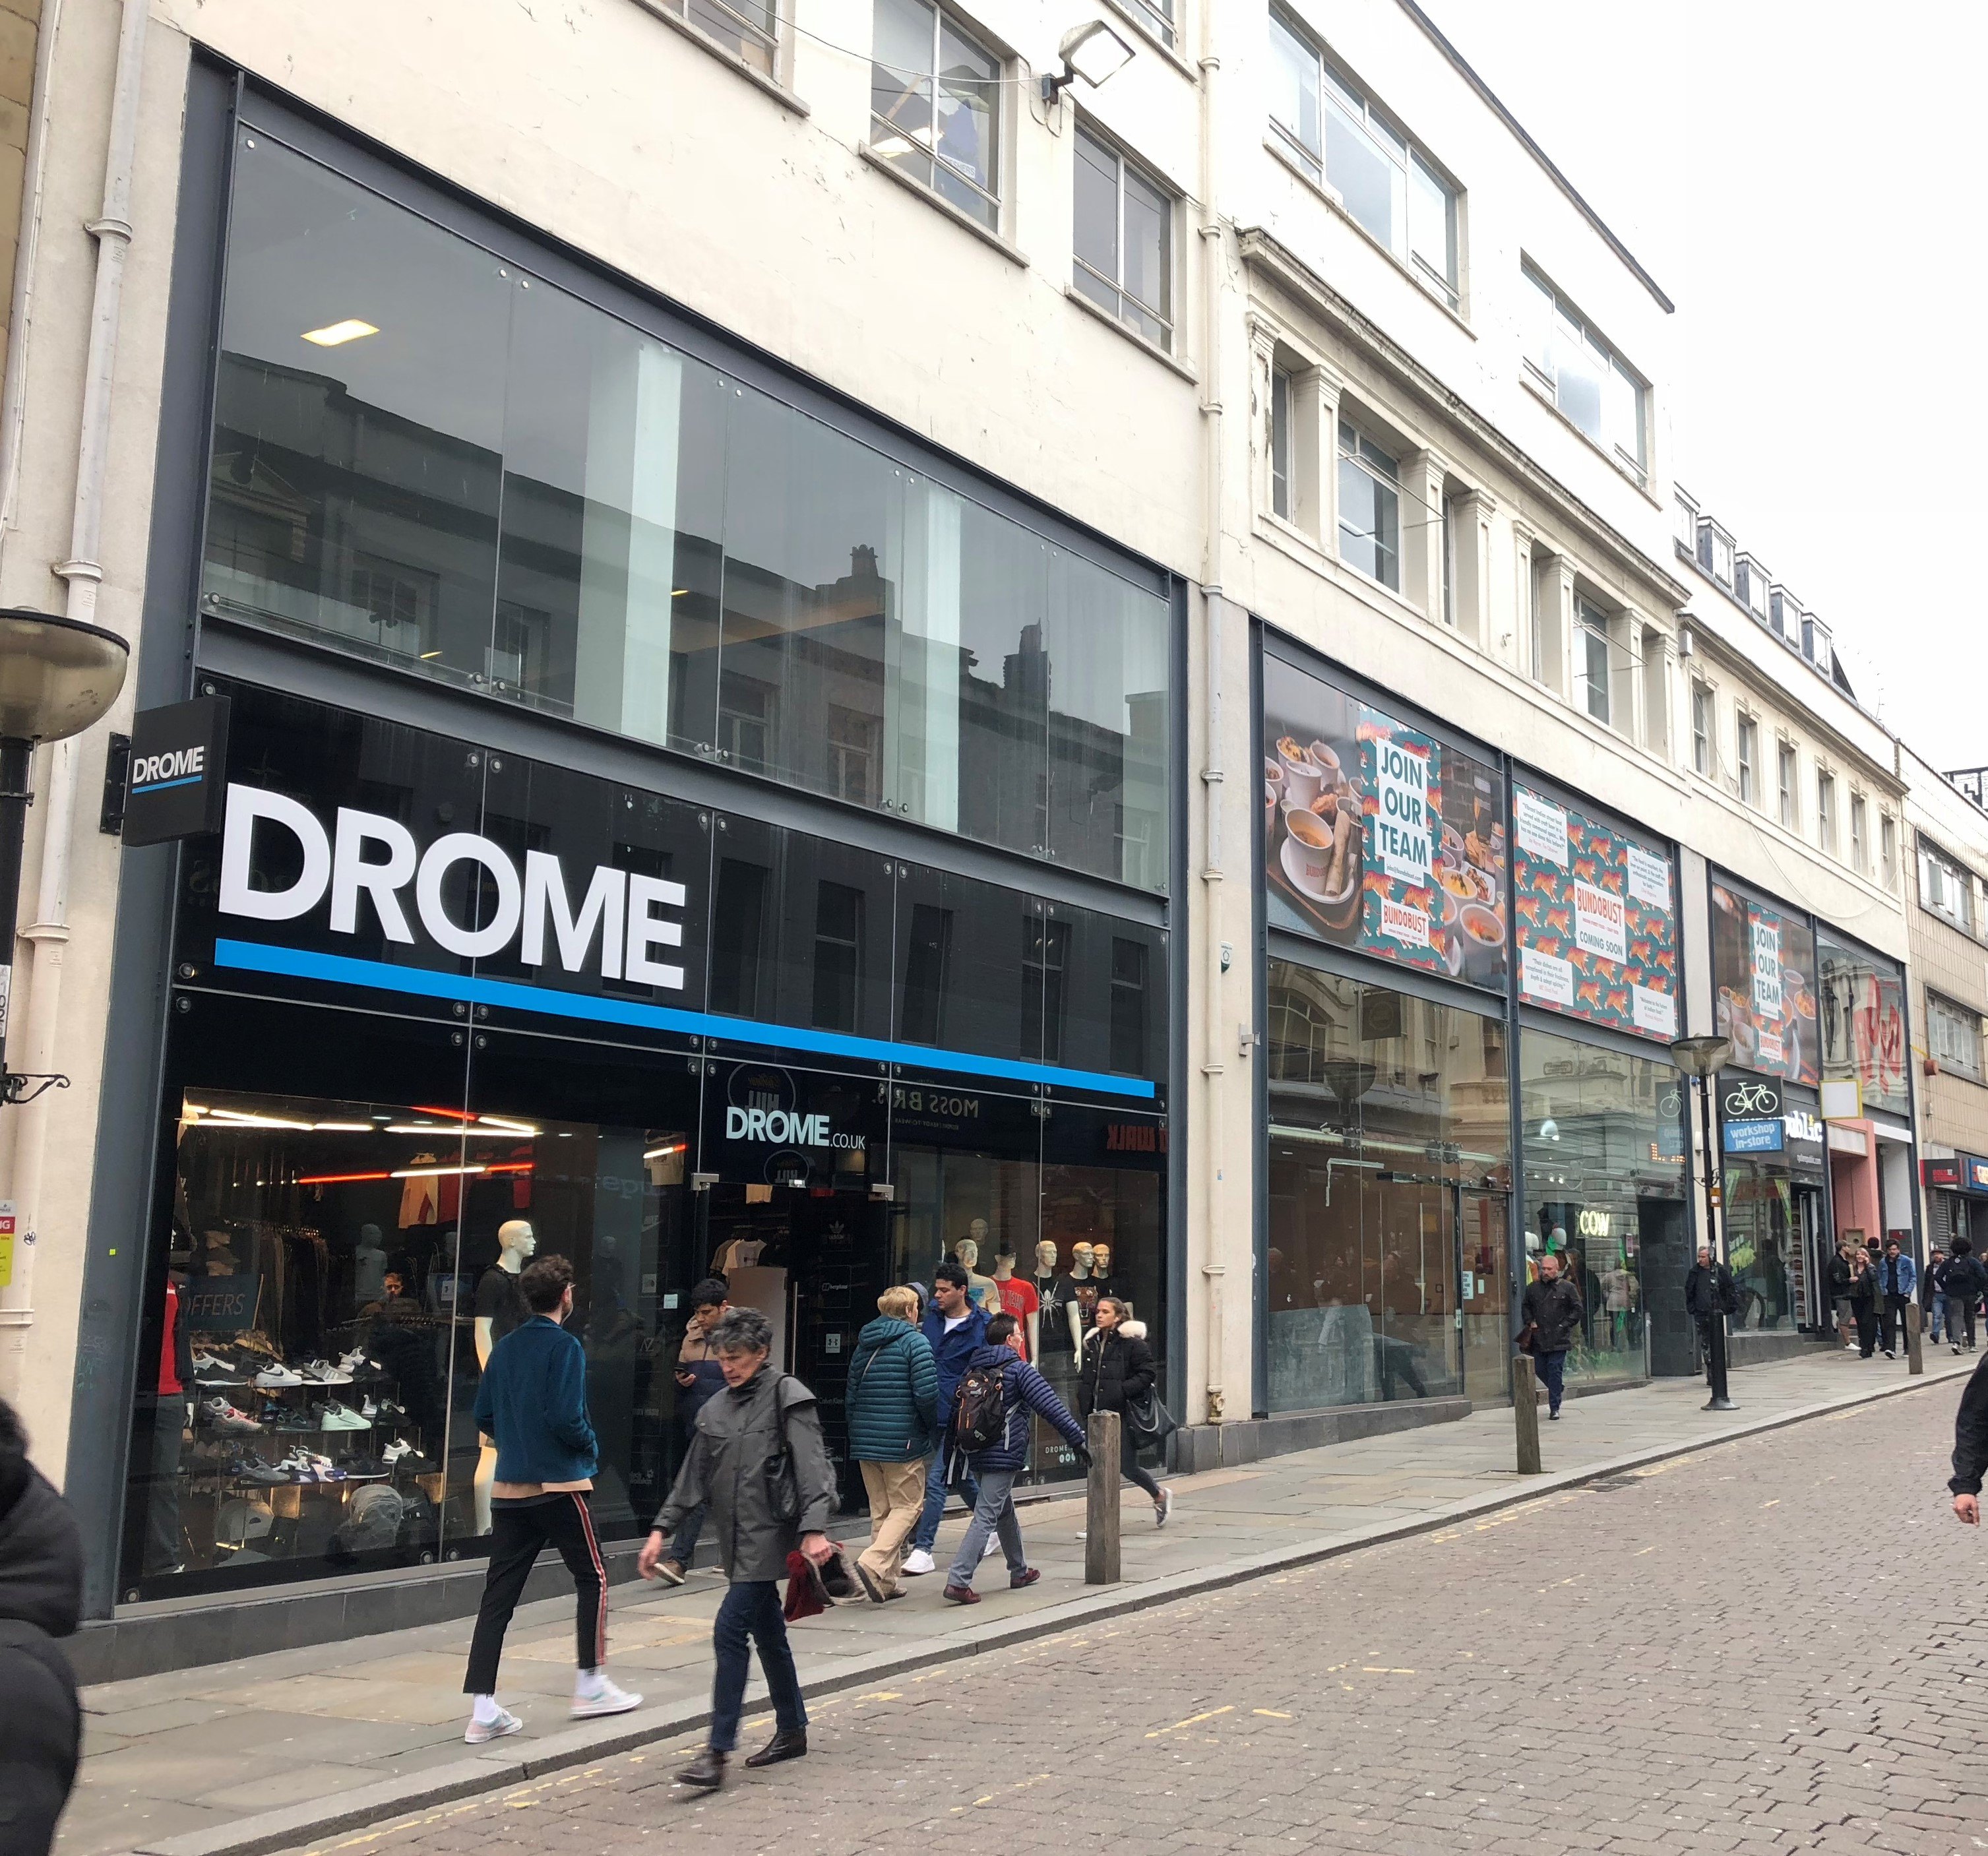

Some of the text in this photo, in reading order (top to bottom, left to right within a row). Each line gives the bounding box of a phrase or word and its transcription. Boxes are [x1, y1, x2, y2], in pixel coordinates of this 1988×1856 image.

[132, 745, 204, 782] DROME
[1381, 747, 1423, 791] JOIN
[1384, 787, 1422, 827] OUR
[1379, 823, 1427, 867] TEAM
[219, 783, 686, 990] DROME
[1384, 904, 1427, 936] BUNDOBUST
[1577, 887, 1622, 927] BUNDOBUST
[1580, 931, 1623, 956] COMING SOON
[1756, 926, 1776, 952] JOIN
[1758, 954, 1776, 979] OUR
[1756, 979, 1780, 1005] TEAM
[726, 1107, 865, 1149] DROME.CO.UK
[1730, 1123, 1775, 1138] workshop
[1735, 1135, 1771, 1149] in-store
[1580, 1211, 1610, 1237] COW
